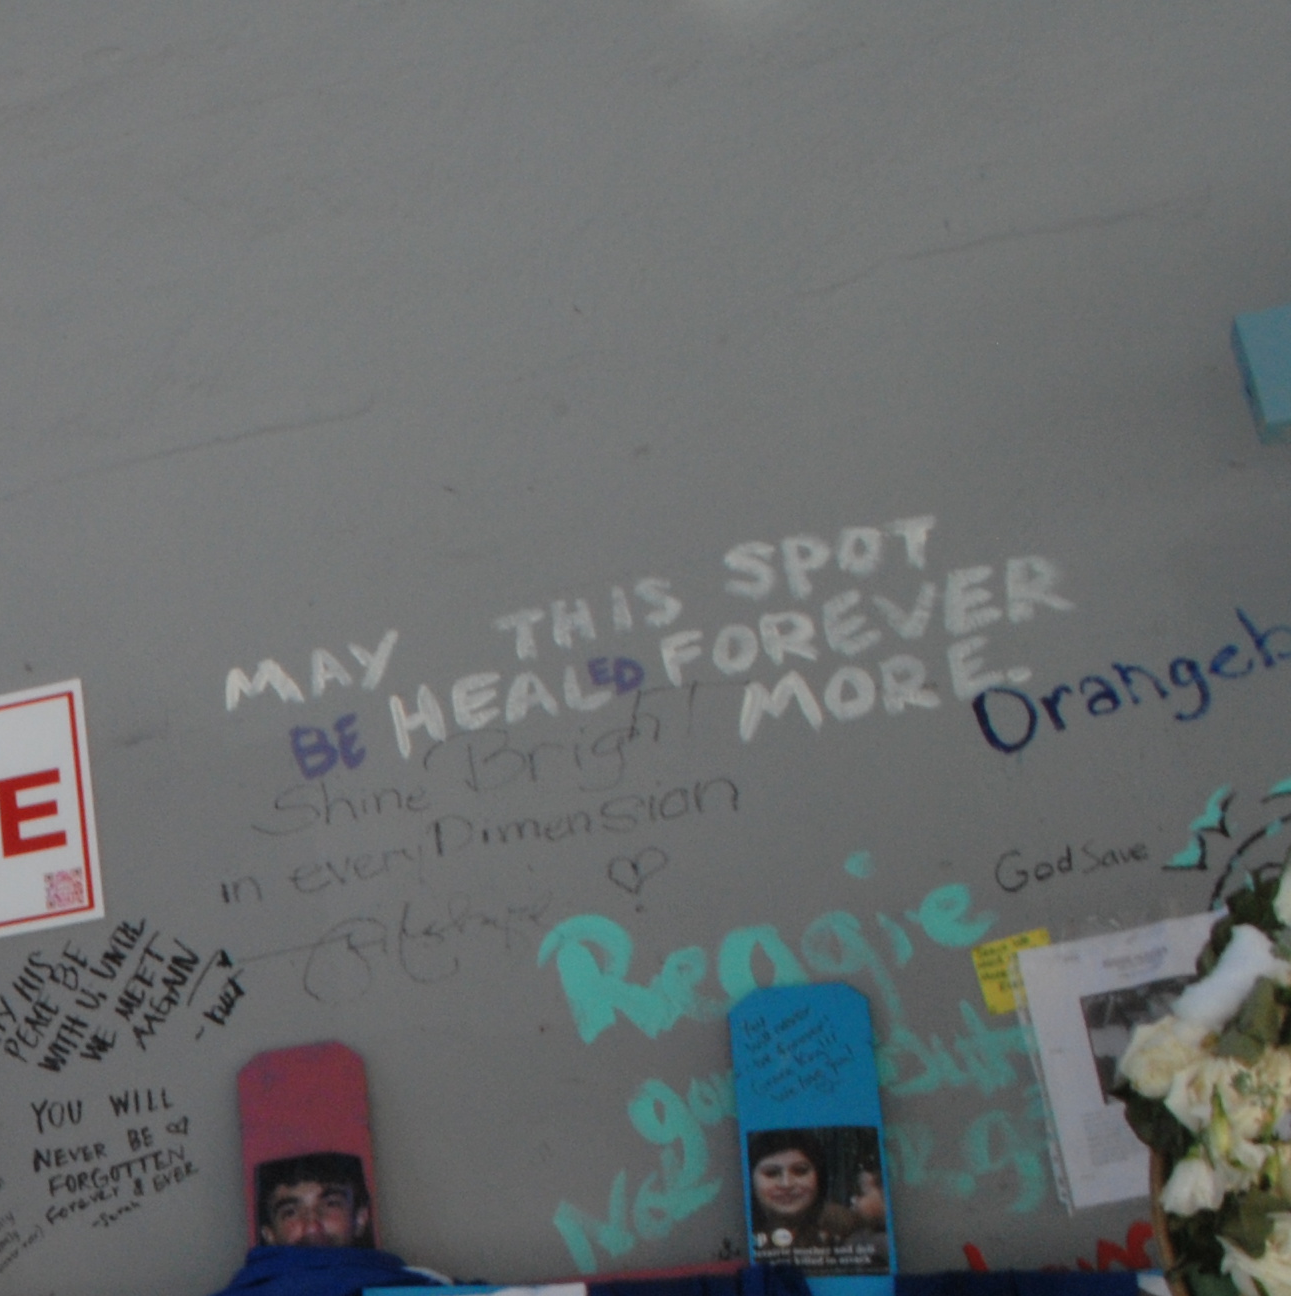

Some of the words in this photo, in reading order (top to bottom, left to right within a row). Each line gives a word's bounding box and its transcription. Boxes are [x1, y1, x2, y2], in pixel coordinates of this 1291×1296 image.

[226, 628, 398, 712] MAY
[493, 576, 683, 660] THIS
[723, 514, 936, 600] SPOT
[289, 712, 367, 780] BE
[660, 555, 1076, 687] FOREVER
[995, 845, 1073, 892] God
[31, 1098, 83, 1135] YOU
[108, 1086, 174, 1118] WILL
[32, 1142, 108, 1173] NEVER
[127, 1126, 155, 1151] BE
[48, 1143, 186, 1198] FORGOTTEN
